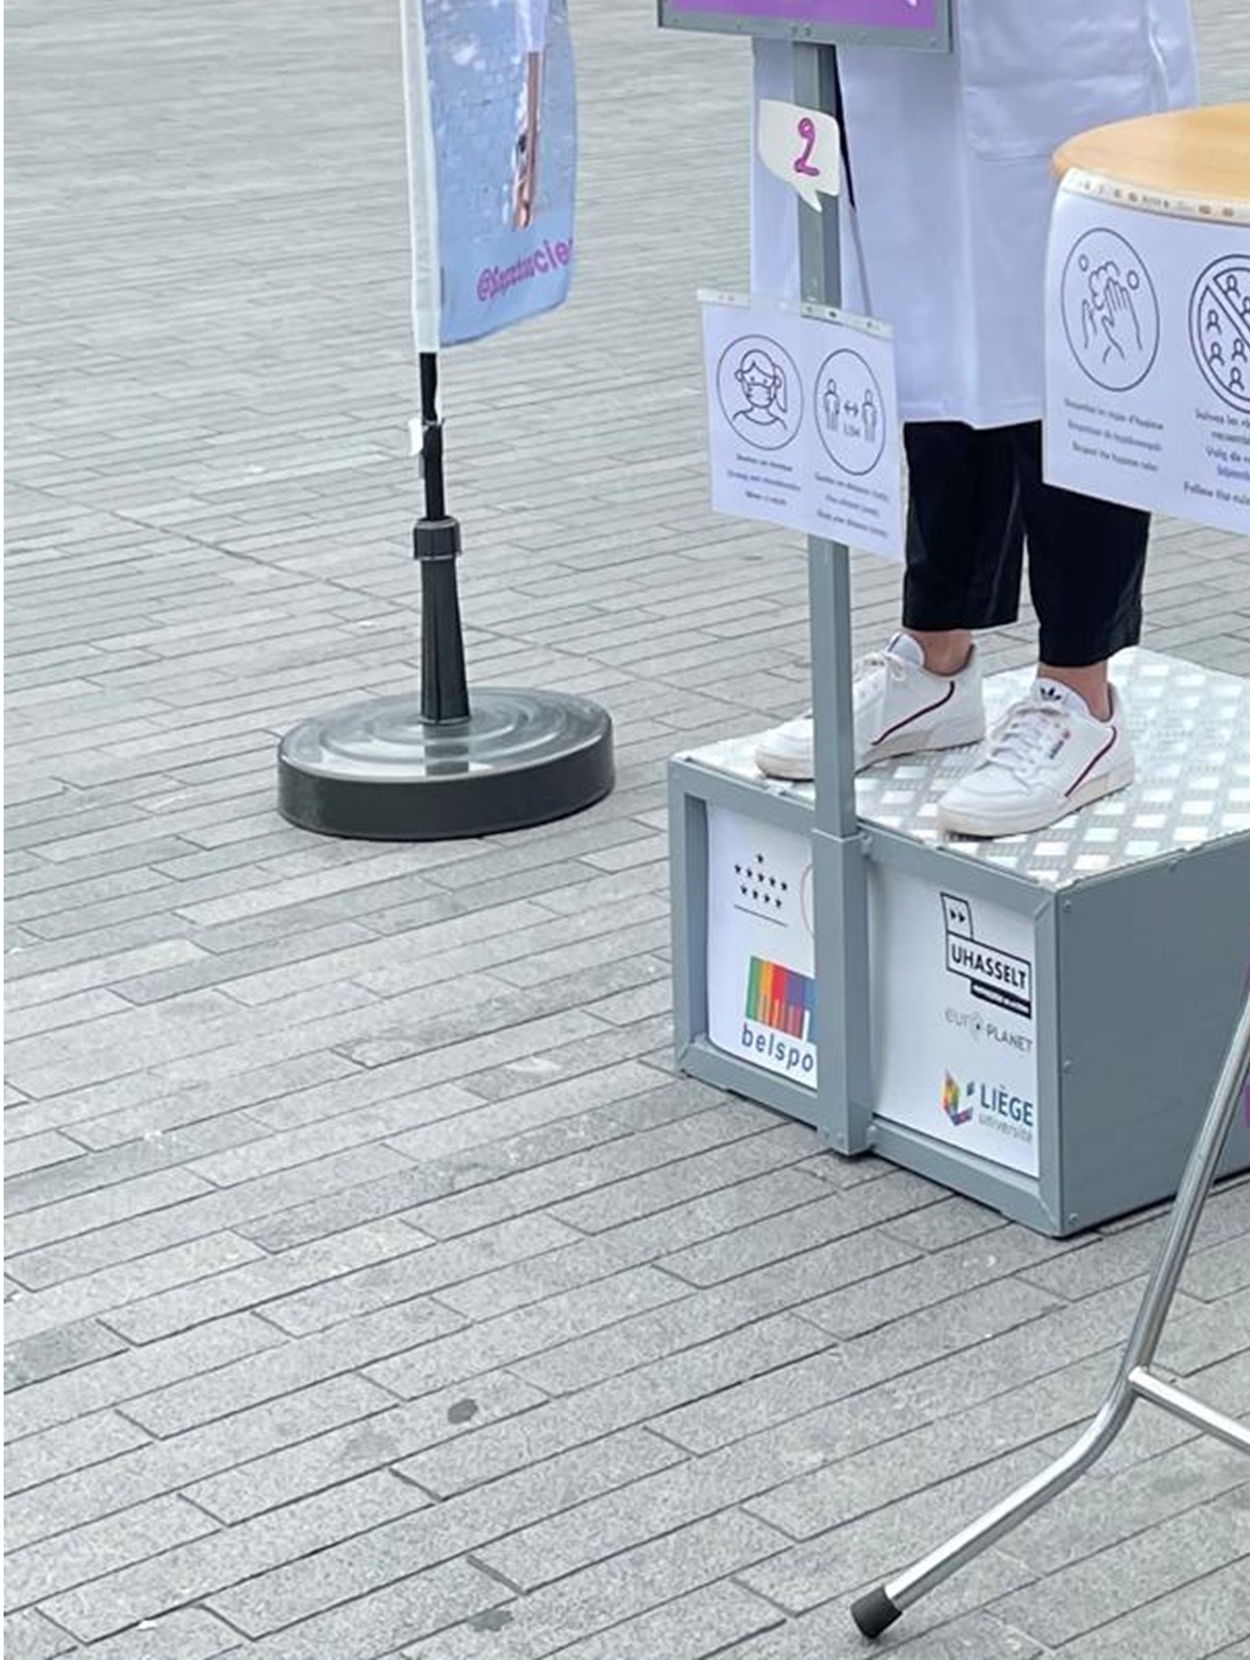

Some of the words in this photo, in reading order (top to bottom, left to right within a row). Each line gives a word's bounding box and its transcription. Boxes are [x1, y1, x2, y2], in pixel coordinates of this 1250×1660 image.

[794, 117, 821, 177] 2
[951, 943, 1027, 990] UHASSELT
[741, 1021, 814, 1073] belspo
